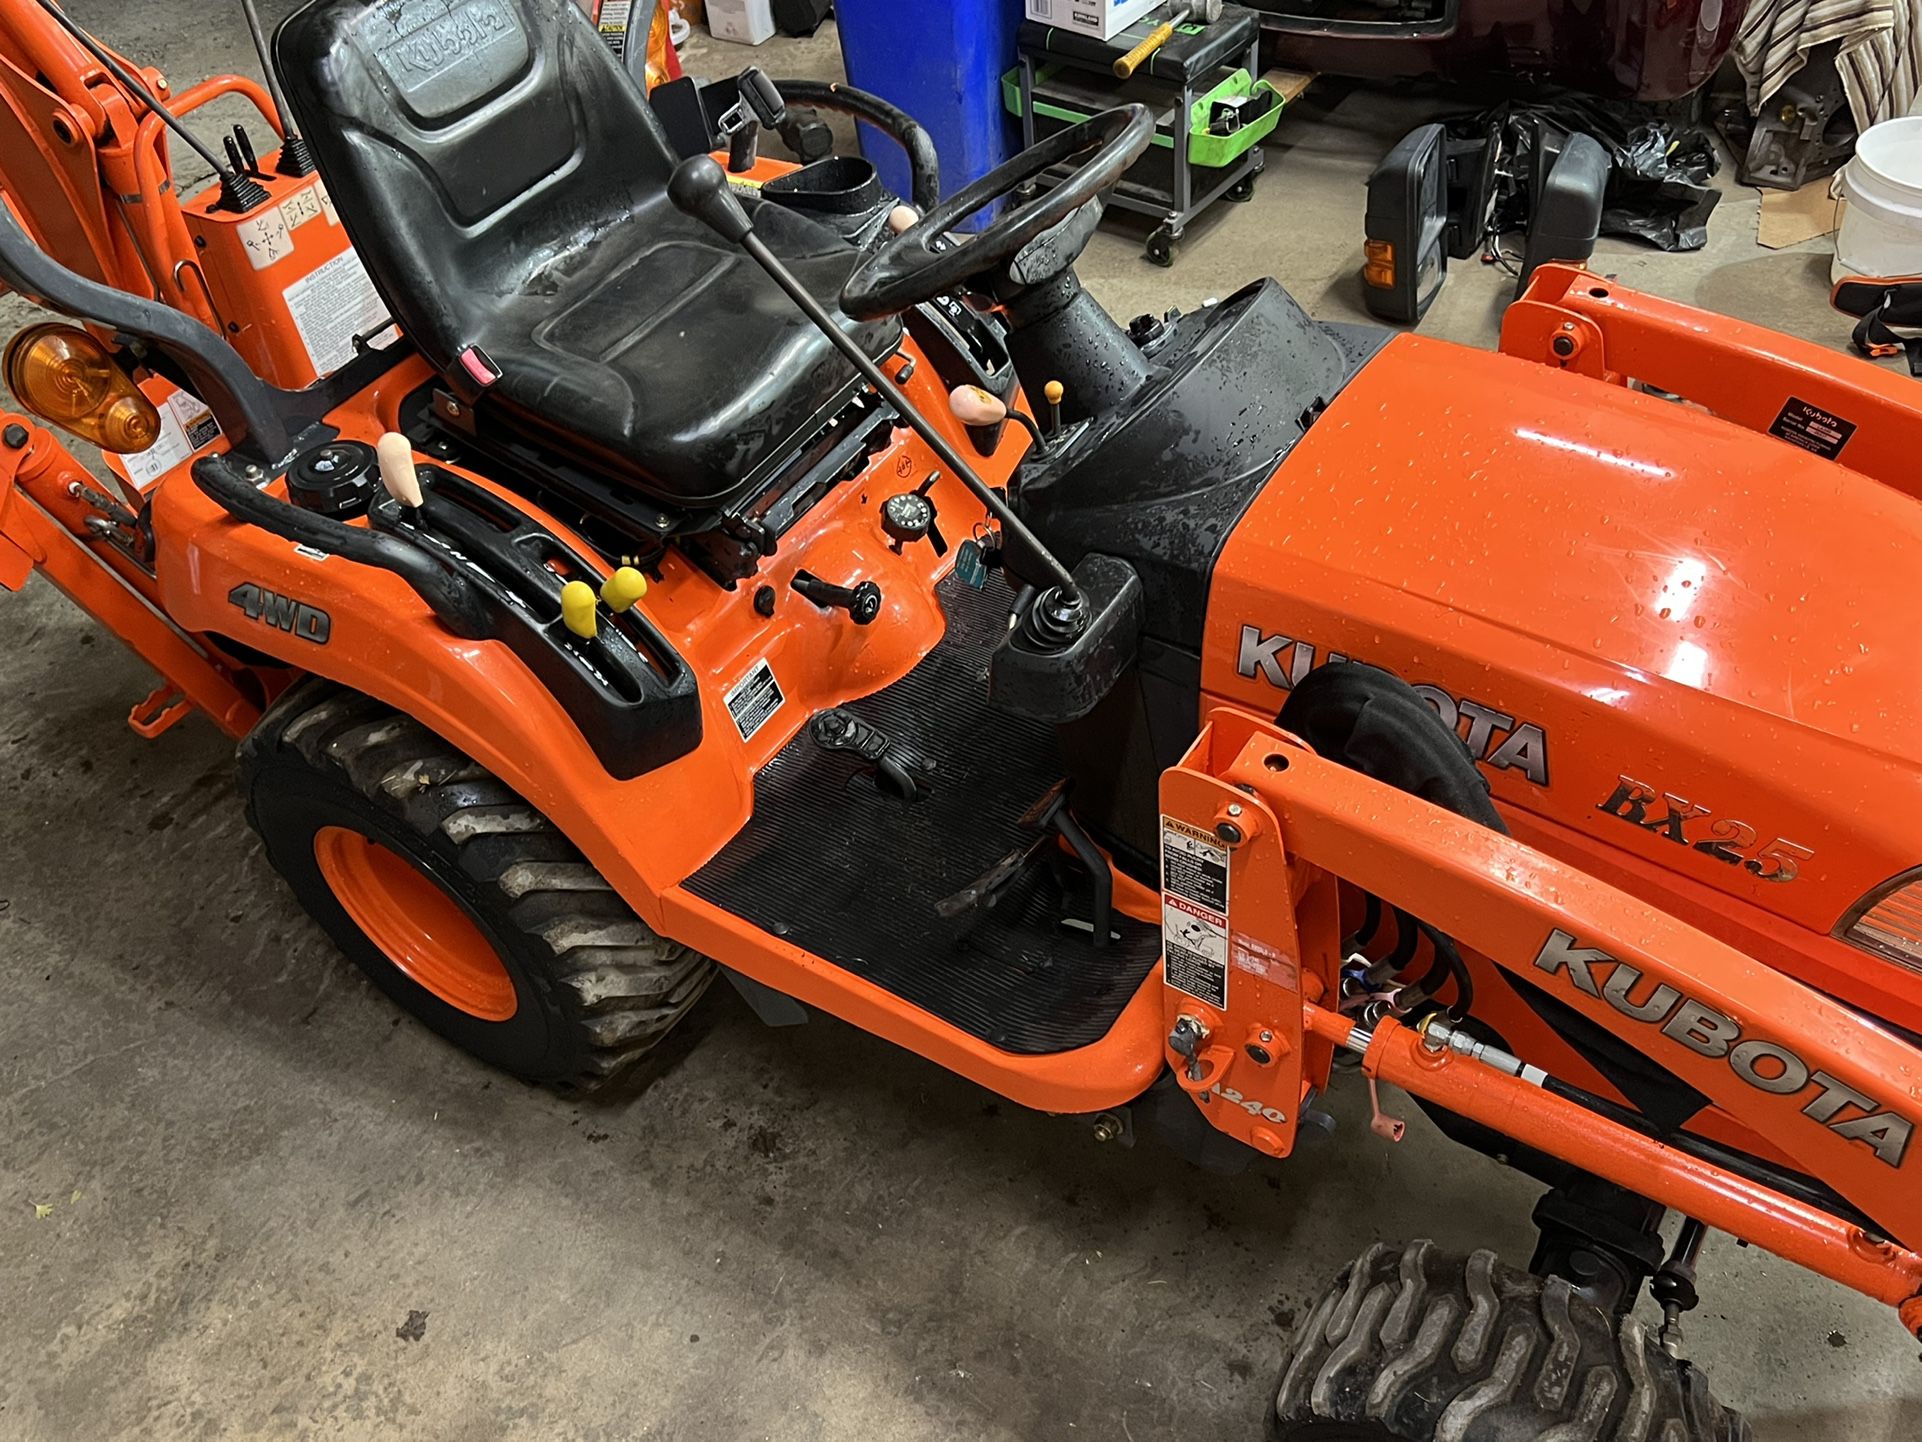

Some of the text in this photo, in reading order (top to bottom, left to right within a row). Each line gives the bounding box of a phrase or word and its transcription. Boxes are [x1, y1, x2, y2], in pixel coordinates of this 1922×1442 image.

[1802, 405, 1838, 428] Kubota
[228, 582, 331, 645] 4WD
[1175, 823, 1226, 850] WARNING
[1595, 774, 1815, 883] BX25
[1178, 901, 1223, 928] DANGER
[1534, 928, 1915, 1169] KUBOTA
